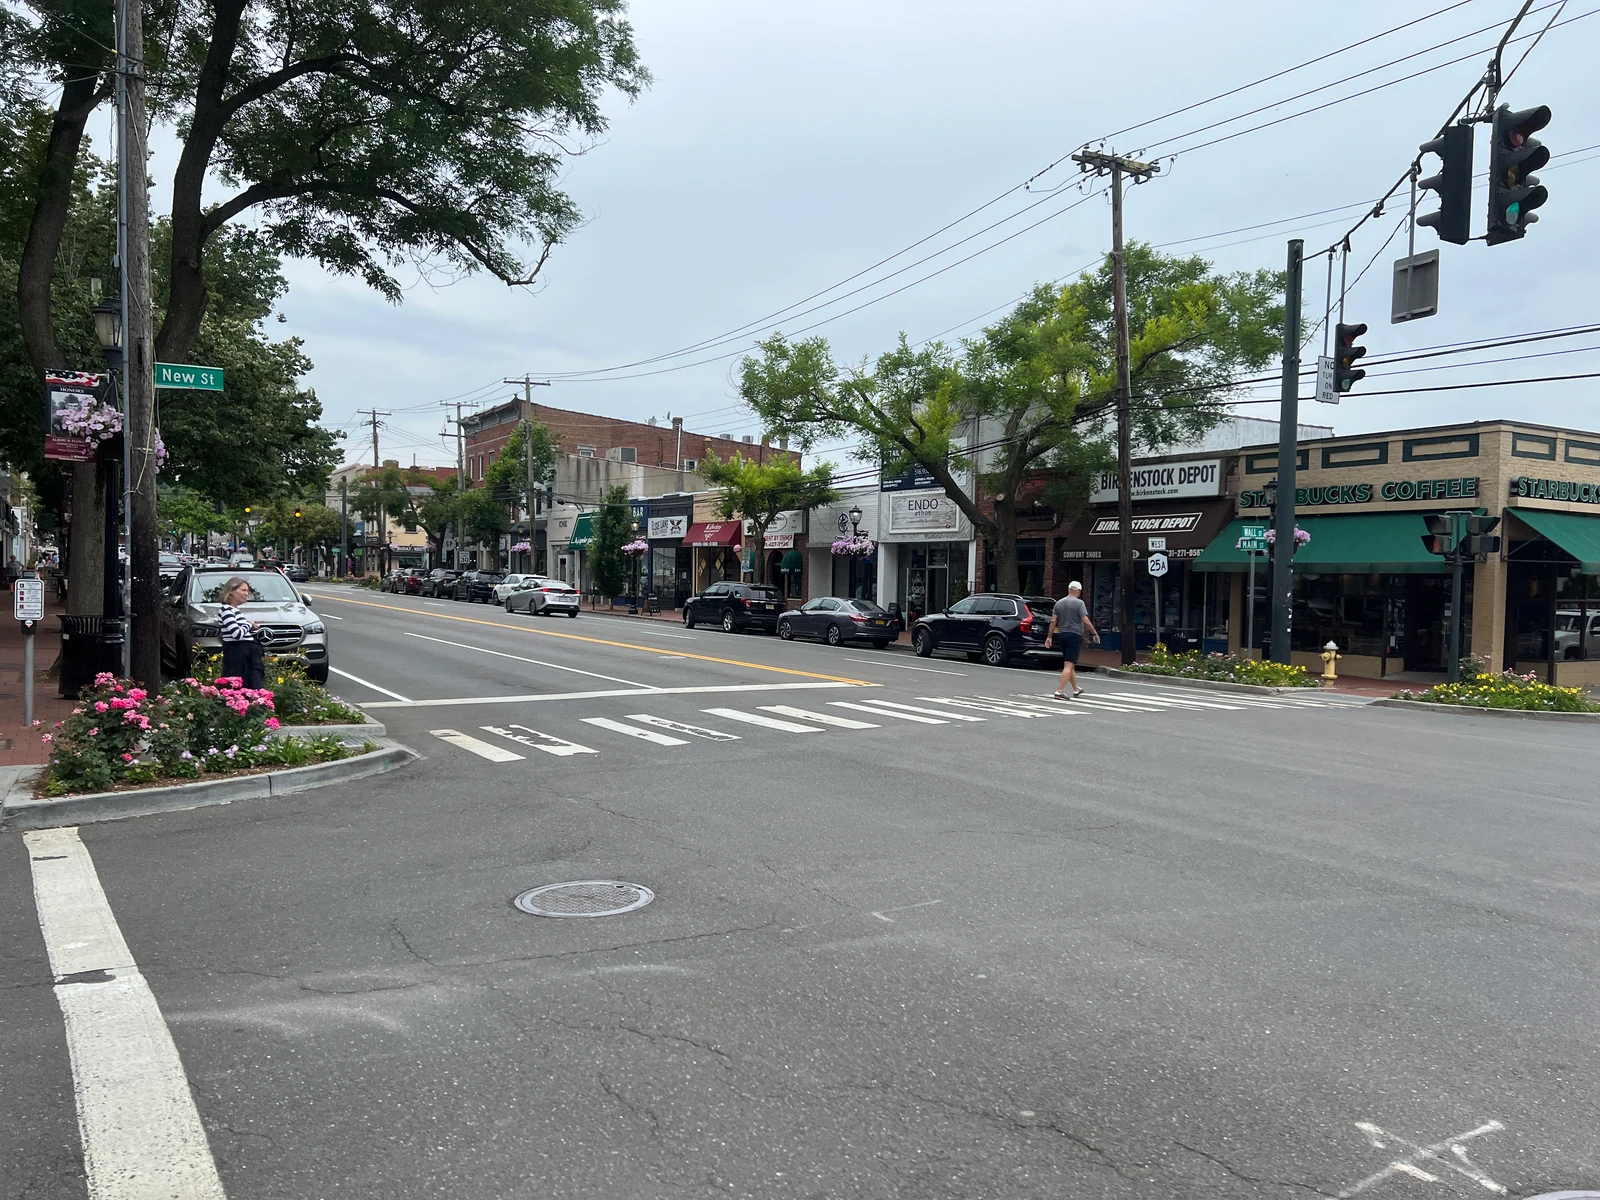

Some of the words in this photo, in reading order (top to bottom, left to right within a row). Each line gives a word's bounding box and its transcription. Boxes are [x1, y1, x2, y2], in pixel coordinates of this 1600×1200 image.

[162, 368, 194, 383] New
[201, 373, 214, 386] St
[1322, 372, 1332, 380] TUR
[1322, 392, 1334, 400] RED
[1178, 465, 1216, 484] DEPOT
[1239, 484, 1372, 507] STBUCKS
[1380, 478, 1477, 501] COFFEE
[1518, 476, 1600, 504] STARBUCK
[908, 498, 938, 510] ENDO
[632, 506, 644, 517] BAR
[1160, 516, 1196, 528] DEPOT
[1244, 528, 1256, 536] WALL
[1151, 540, 1164, 549] WEST
[1242, 540, 1258, 548] MAIN
[1150, 560, 1167, 572] 25A
